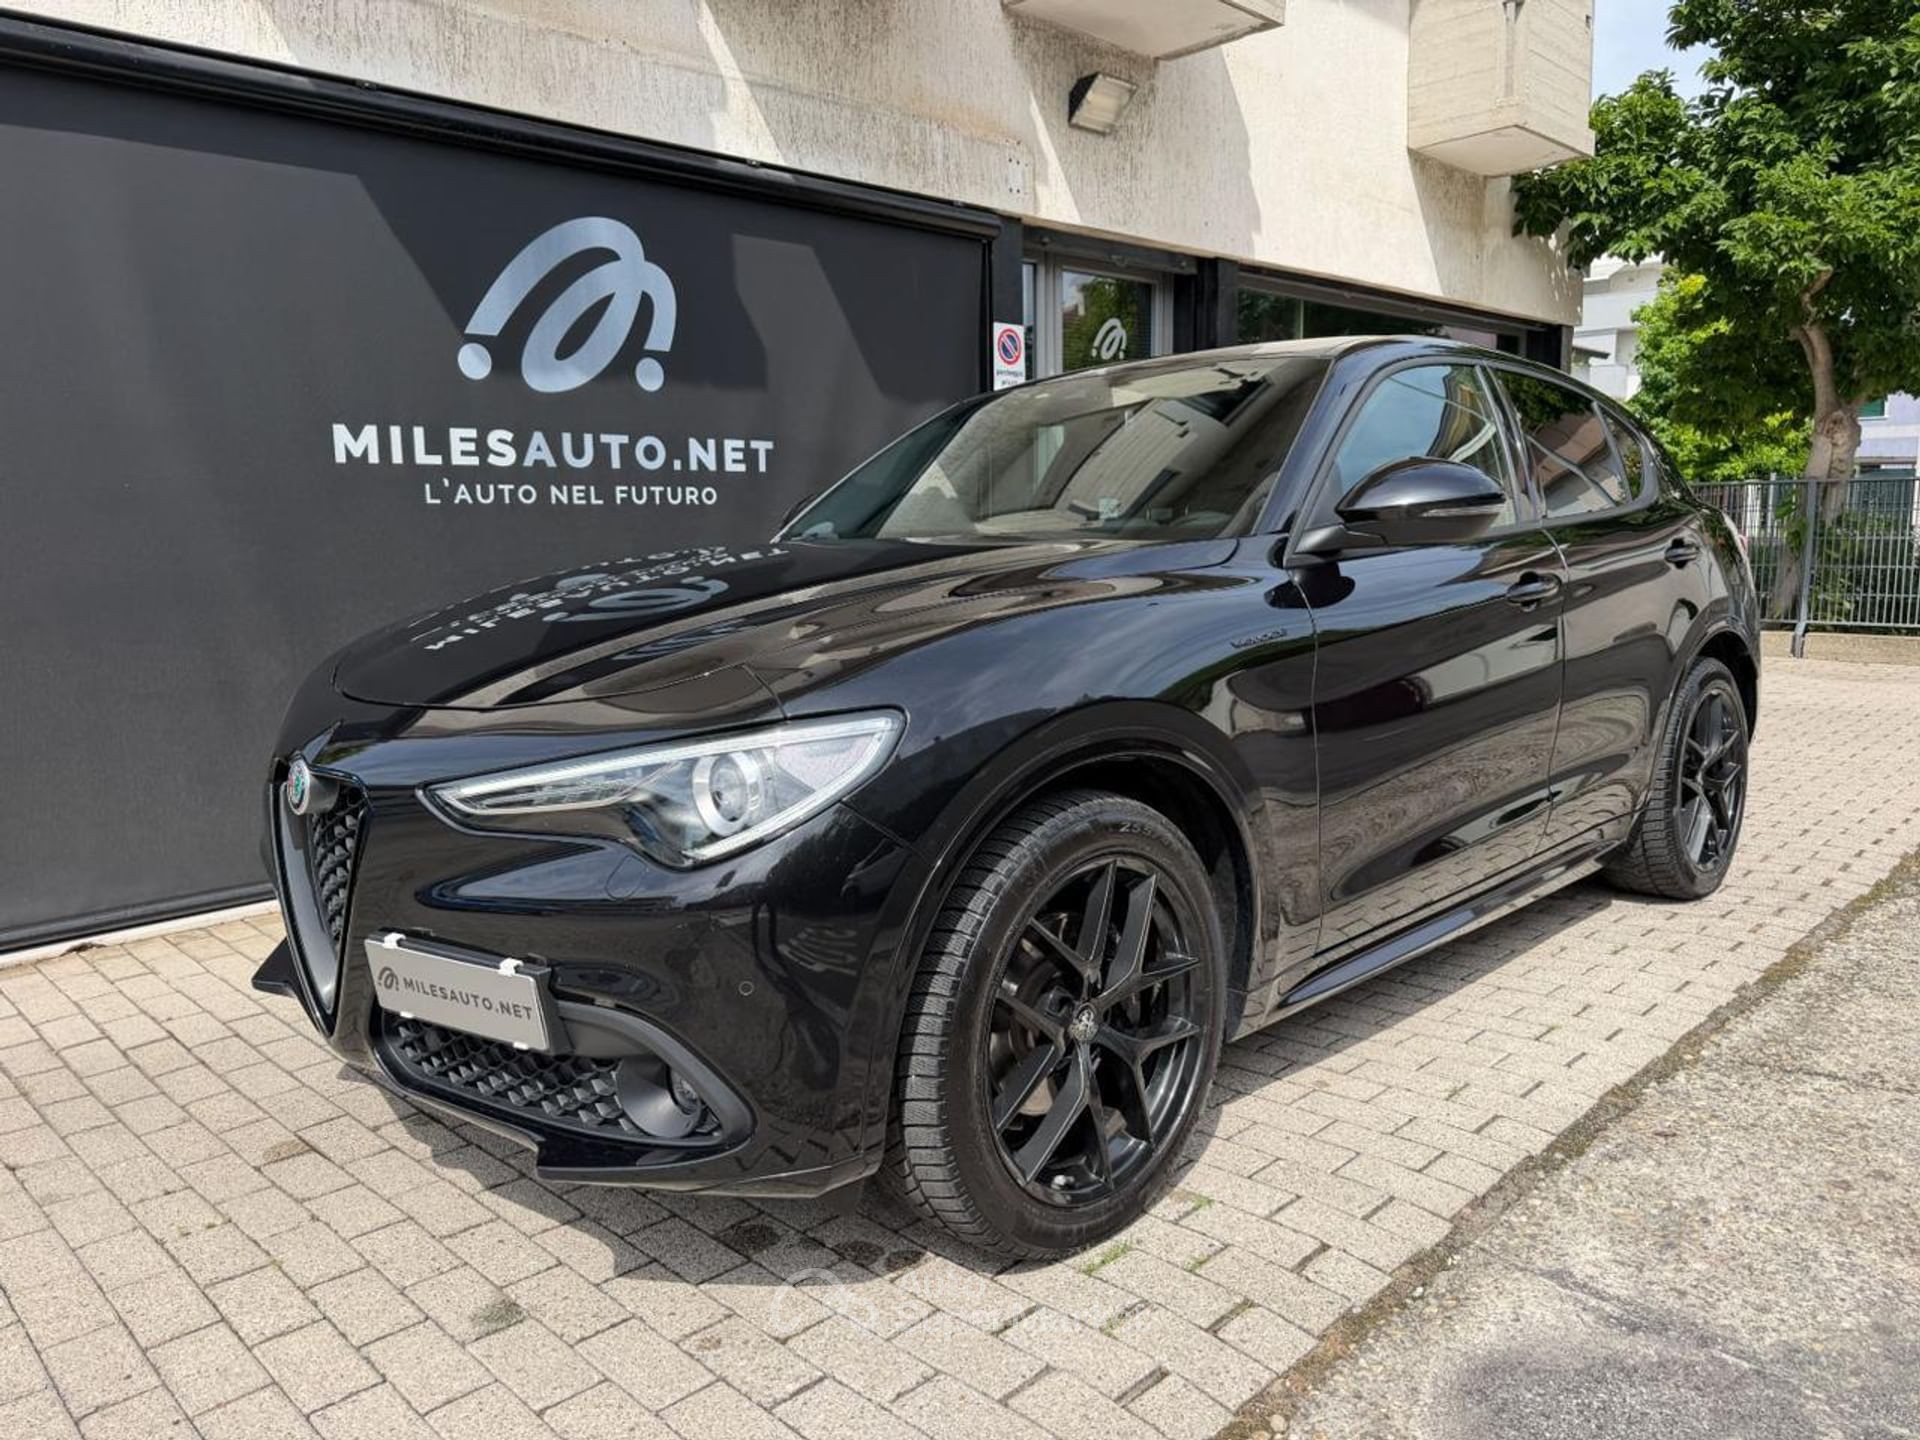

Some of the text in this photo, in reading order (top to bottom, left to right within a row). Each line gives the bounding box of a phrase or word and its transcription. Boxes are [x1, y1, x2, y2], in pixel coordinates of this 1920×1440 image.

[331, 423, 775, 473] MILESAUTO.NET
[424, 477, 718, 506] L'AUTO NEL FUTURO
[403, 977, 532, 1020] MILESAUTO.NET
